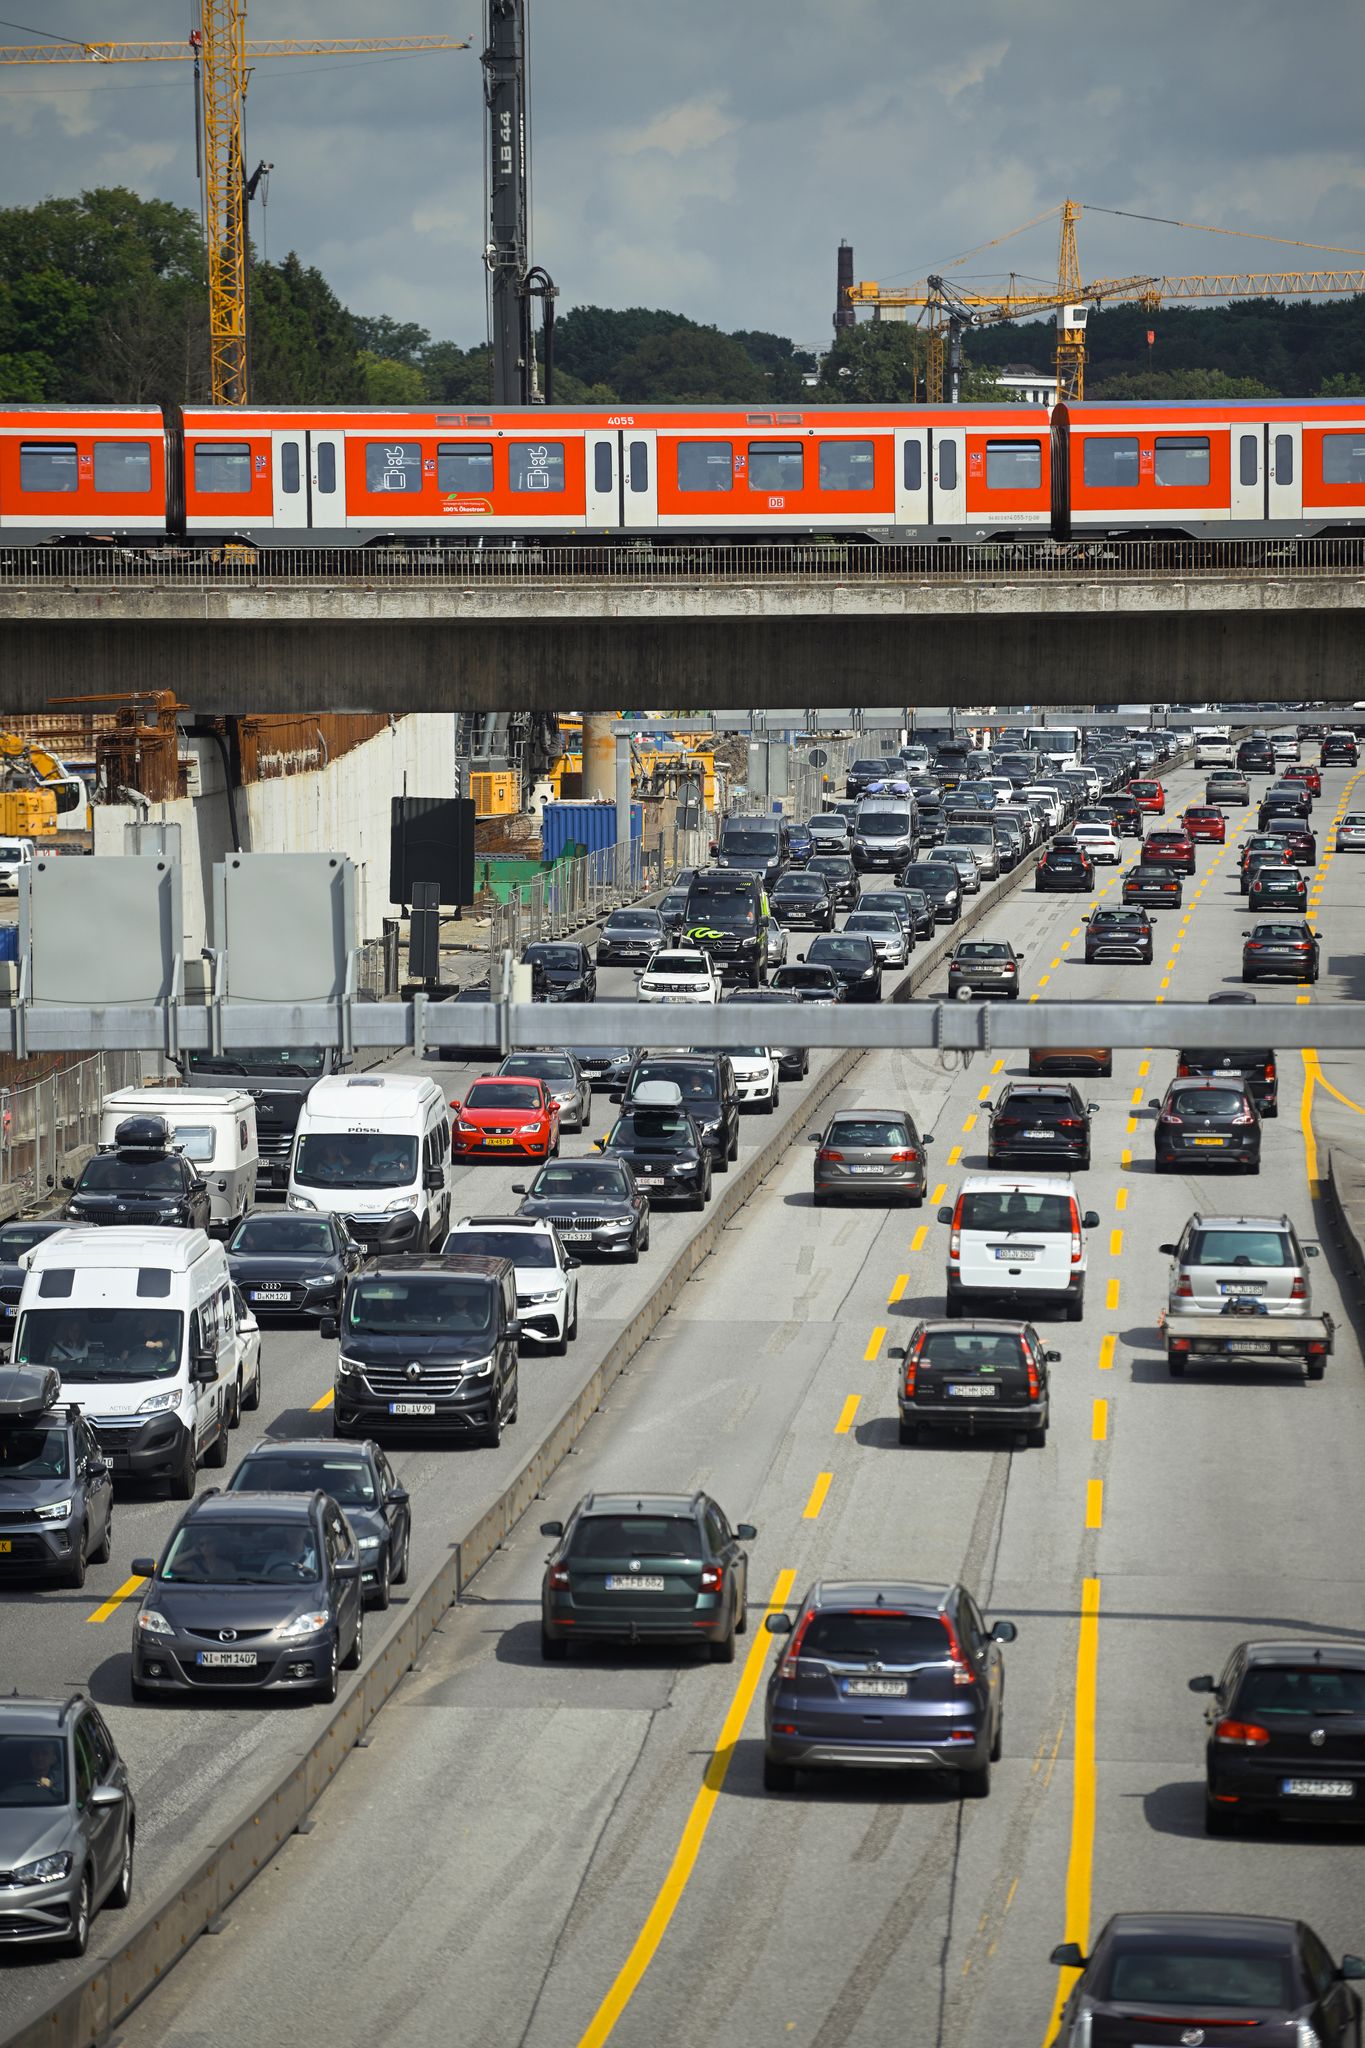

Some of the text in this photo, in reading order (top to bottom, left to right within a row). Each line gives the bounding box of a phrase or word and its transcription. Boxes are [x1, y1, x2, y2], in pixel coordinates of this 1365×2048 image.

[500, 111, 512, 173] LB 44
[608, 417, 634, 425] 4055
[770, 498, 783, 507] DB
[395, 1405, 407, 1413] RD
[422, 1405, 432, 1413] 99
[202, 1653, 256, 1664] NI MM 1407
